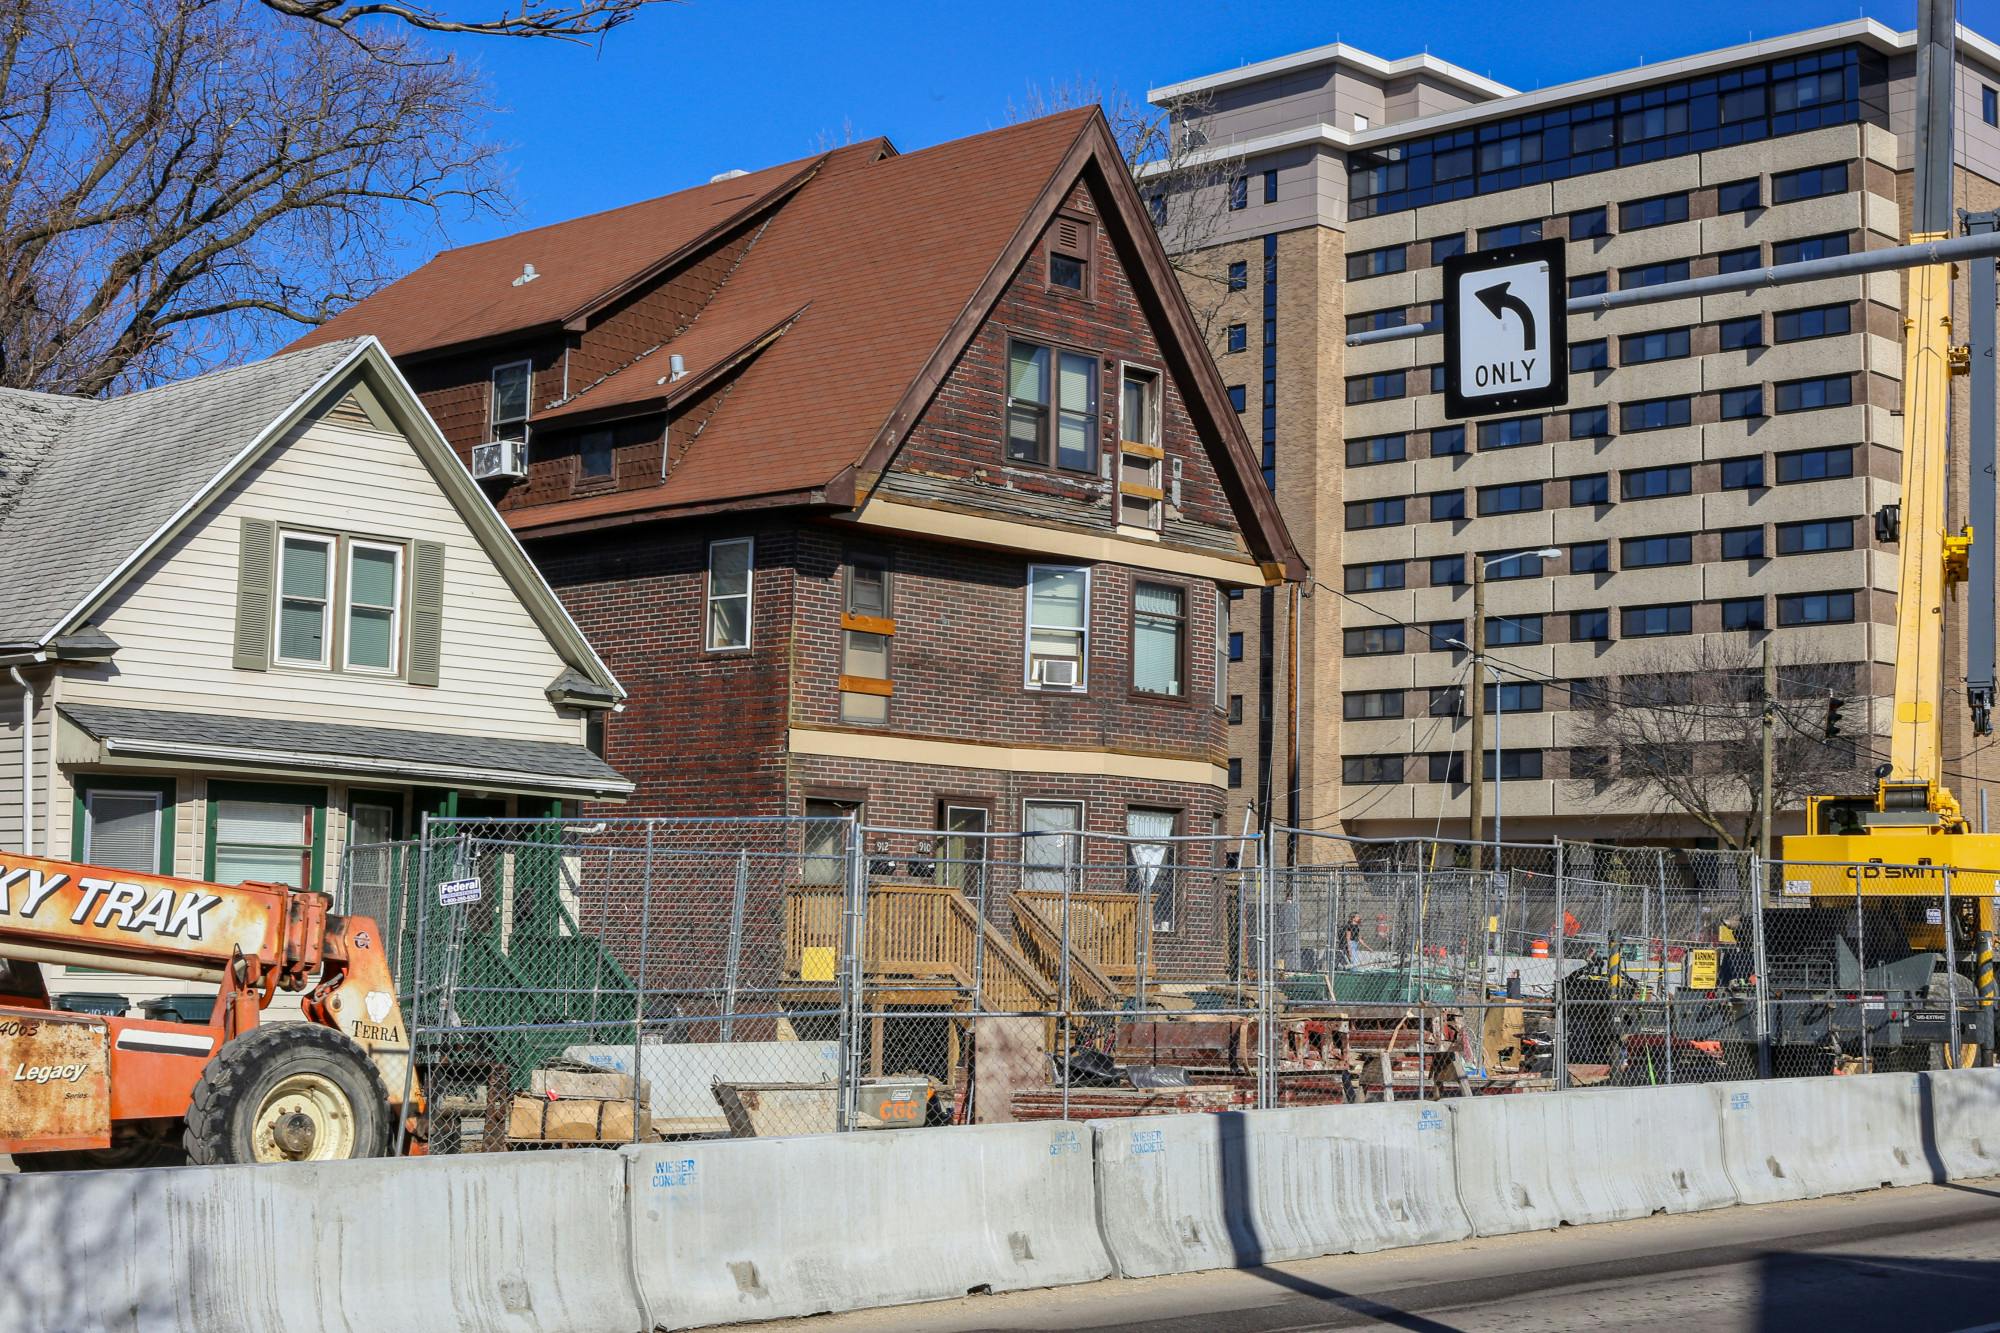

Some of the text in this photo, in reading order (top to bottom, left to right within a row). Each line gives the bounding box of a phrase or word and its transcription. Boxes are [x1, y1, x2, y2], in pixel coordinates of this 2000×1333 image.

[1475, 358, 1536, 387] ONLY
[876, 841, 889, 852] 912
[441, 879, 479, 894] Federal
[70, 877, 223, 941] TRAK
[351, 1019, 401, 1043] TERRA
[14, 1062, 88, 1085] Legacy
[64, 1092, 88, 1100] Series
[1132, 1130, 1162, 1142] WIESER
[1130, 1141, 1166, 1154] CONCRETE
[655, 1159, 695, 1174] WIESER
[652, 1173, 700, 1187] CONCRETE
